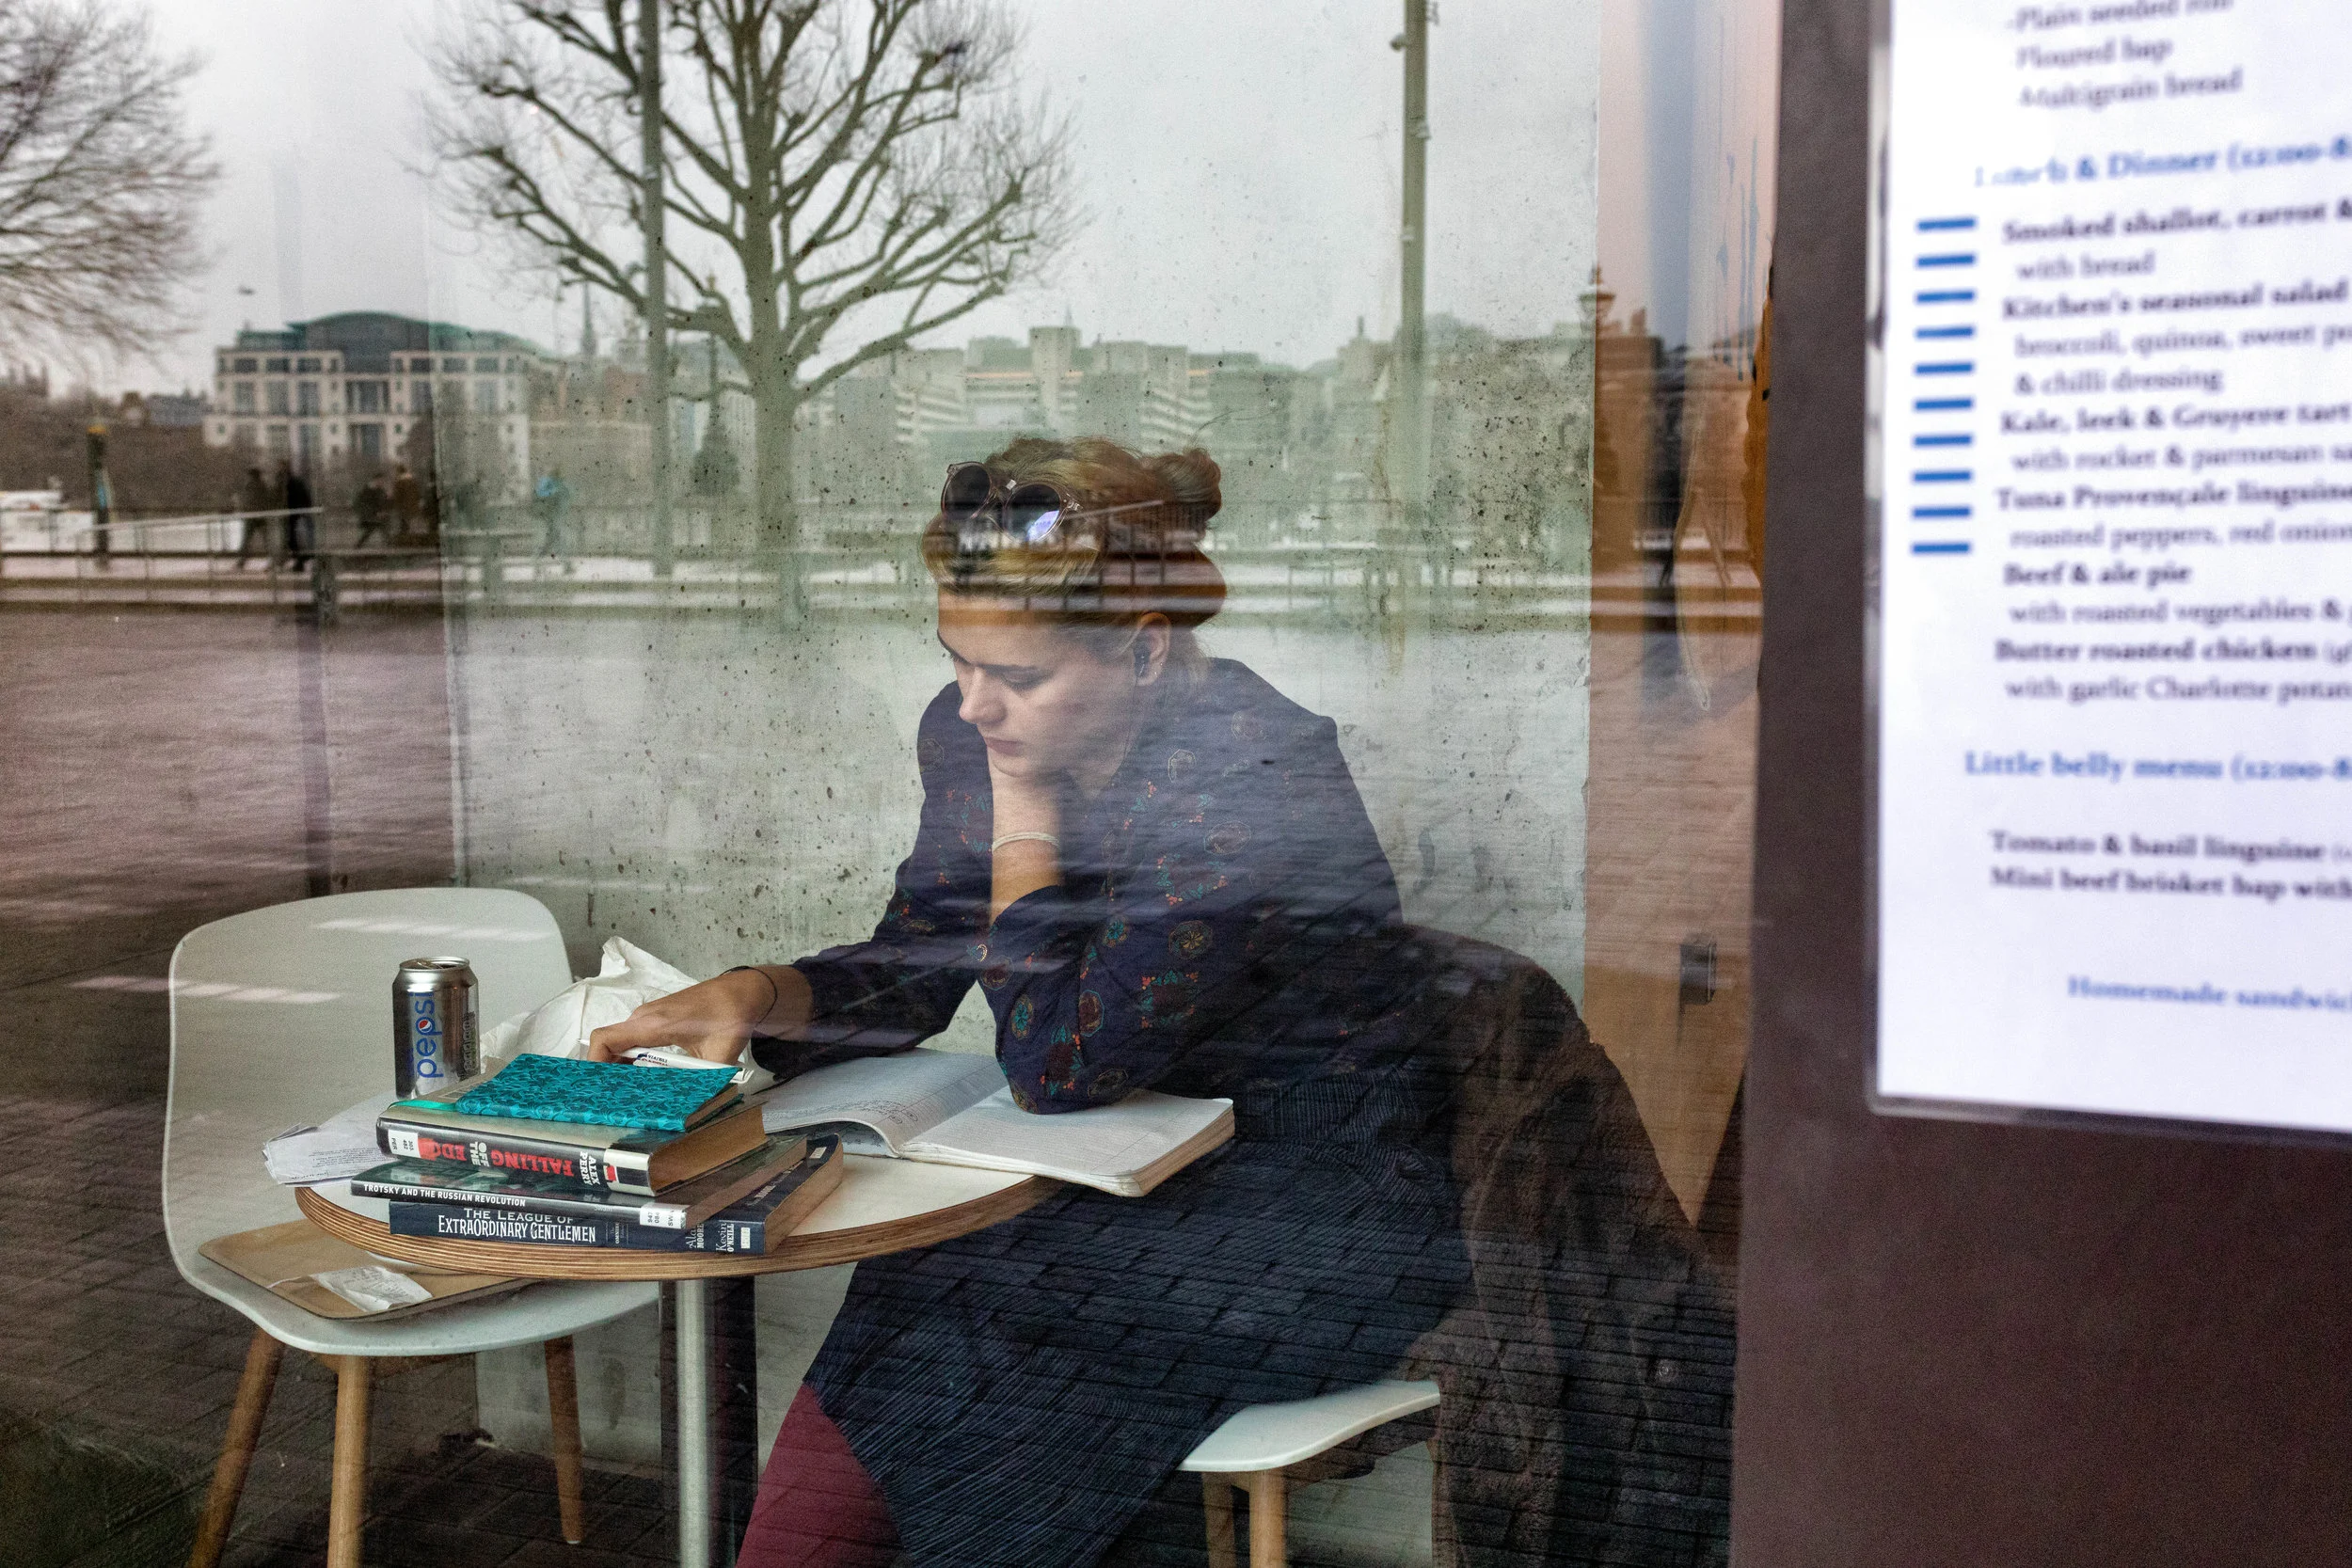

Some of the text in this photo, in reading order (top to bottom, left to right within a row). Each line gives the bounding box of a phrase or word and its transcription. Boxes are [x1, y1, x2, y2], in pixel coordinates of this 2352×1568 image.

[2122, 35, 2173, 64] bap
[2165, 63, 2244, 98] bread
[2074, 154, 2098, 182] &
[2107, 149, 2217, 179] Dinner
[2003, 211, 2116, 244] Smoked
[2122, 205, 2232, 235] shallot,
[2236, 200, 2328, 229] carrot
[2016, 247, 2156, 280] with bread
[2002, 276, 2350, 321] Kitchen's seasonal salad
[2014, 327, 2128, 357] broccoli,
[2131, 326, 2234, 360] quinoa,
[2237, 325, 2317, 349] sweet
[2014, 363, 2224, 396] & chilli dressing
[2000, 407, 2071, 436] Kale,
[2075, 405, 2137, 433] leek
[2144, 404, 2166, 431] &
[2010, 445, 2070, 470] with
[2074, 443, 2157, 468] rocket
[2165, 442, 2186, 467] &
[2191, 445, 2325, 475] parmesan
[1993, 485, 2067, 510] Tuna
[2010, 520, 2106, 547] roasted
[2110, 525, 2224, 555] peppers,
[2229, 516, 2276, 546] red
[2003, 560, 2193, 592] Beef & ale pie
[2008, 598, 2067, 625] with
[2072, 596, 2169, 625] roasted
[2175, 595, 2313, 630] vegetables
[2319, 595, 2344, 623] &
[1994, 637, 2081, 662] Butter
[2088, 635, 2197, 662] roasted
[2200, 633, 2319, 662] chicken
[2004, 673, 2064, 699] with
[2069, 674, 2139, 706] garlic
[2145, 673, 2271, 701] Charlotte
[1965, 750, 2044, 776] Little
[2051, 749, 2124, 784] belly
[2133, 758, 2224, 780] menu
[1990, 829, 2097, 855] Tomato
[2102, 832, 2125, 857] &
[2203, 832, 2328, 868] linguine
[1990, 865, 2056, 891] Mini
[2059, 867, 2122, 893] beef
[2125, 869, 2226, 896] brisket
[2231, 871, 2288, 907] bap
[2068, 974, 2352, 1014] Homemade sandwic
[408, 990, 444, 1079] pepsi
[469, 1141, 482, 1166] THE
[478, 1142, 490, 1167] OFF
[490, 1148, 575, 1178] FALLING
[580, 1150, 594, 1186] PERRY
[588, 1155, 601, 1186] ALEX
[363, 1183, 526, 1208] TROTSKY AND THE RUSSIAN REVOLUTION
[437, 1214, 528, 1240] EXTRAORDINARY
[530, 1221, 596, 1243] GENTLEMEN
[464, 1208, 575, 1224] THE LEAGUE OF
[685, 1226, 697, 1249] Ala
[696, 1223, 705, 1249] MOORE
[715, 1222, 727, 1252] Kevin
[726, 1223, 735, 1253] O'NEILL
